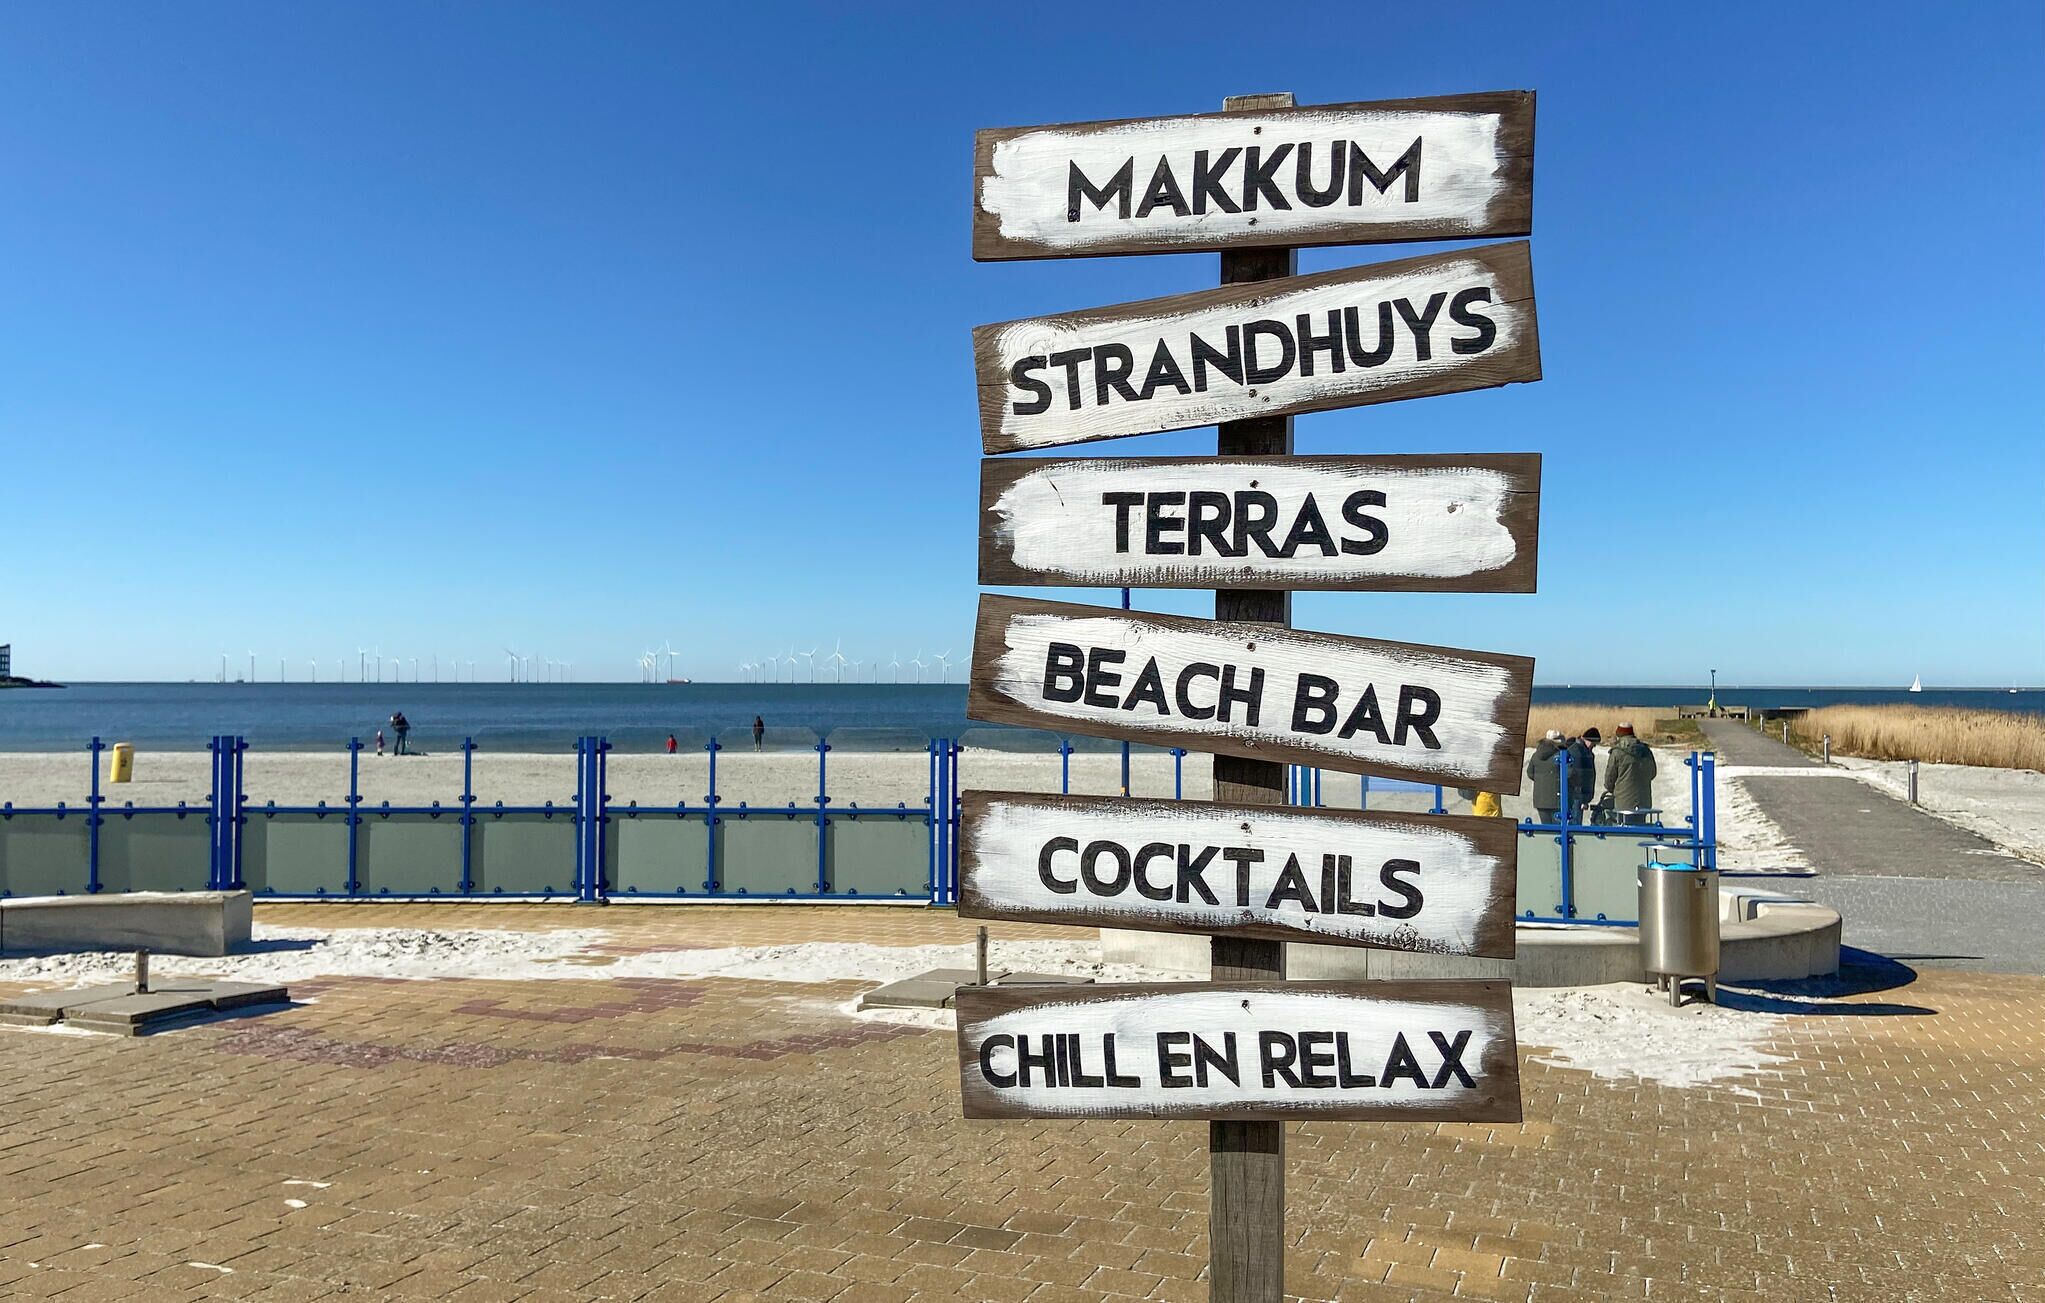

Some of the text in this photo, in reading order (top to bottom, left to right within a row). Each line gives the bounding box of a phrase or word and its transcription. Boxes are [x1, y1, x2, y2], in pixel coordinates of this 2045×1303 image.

[1068, 136, 1422, 222] MAKKUM
[1012, 287, 1497, 415] STRANDHUYS
[1102, 490, 1389, 557] TERRAS
[1042, 642, 1442, 750] BEACH BAR
[1038, 836, 1424, 919] COCKTAILS
[979, 1030, 1477, 1089] CHILL EN RELAX
